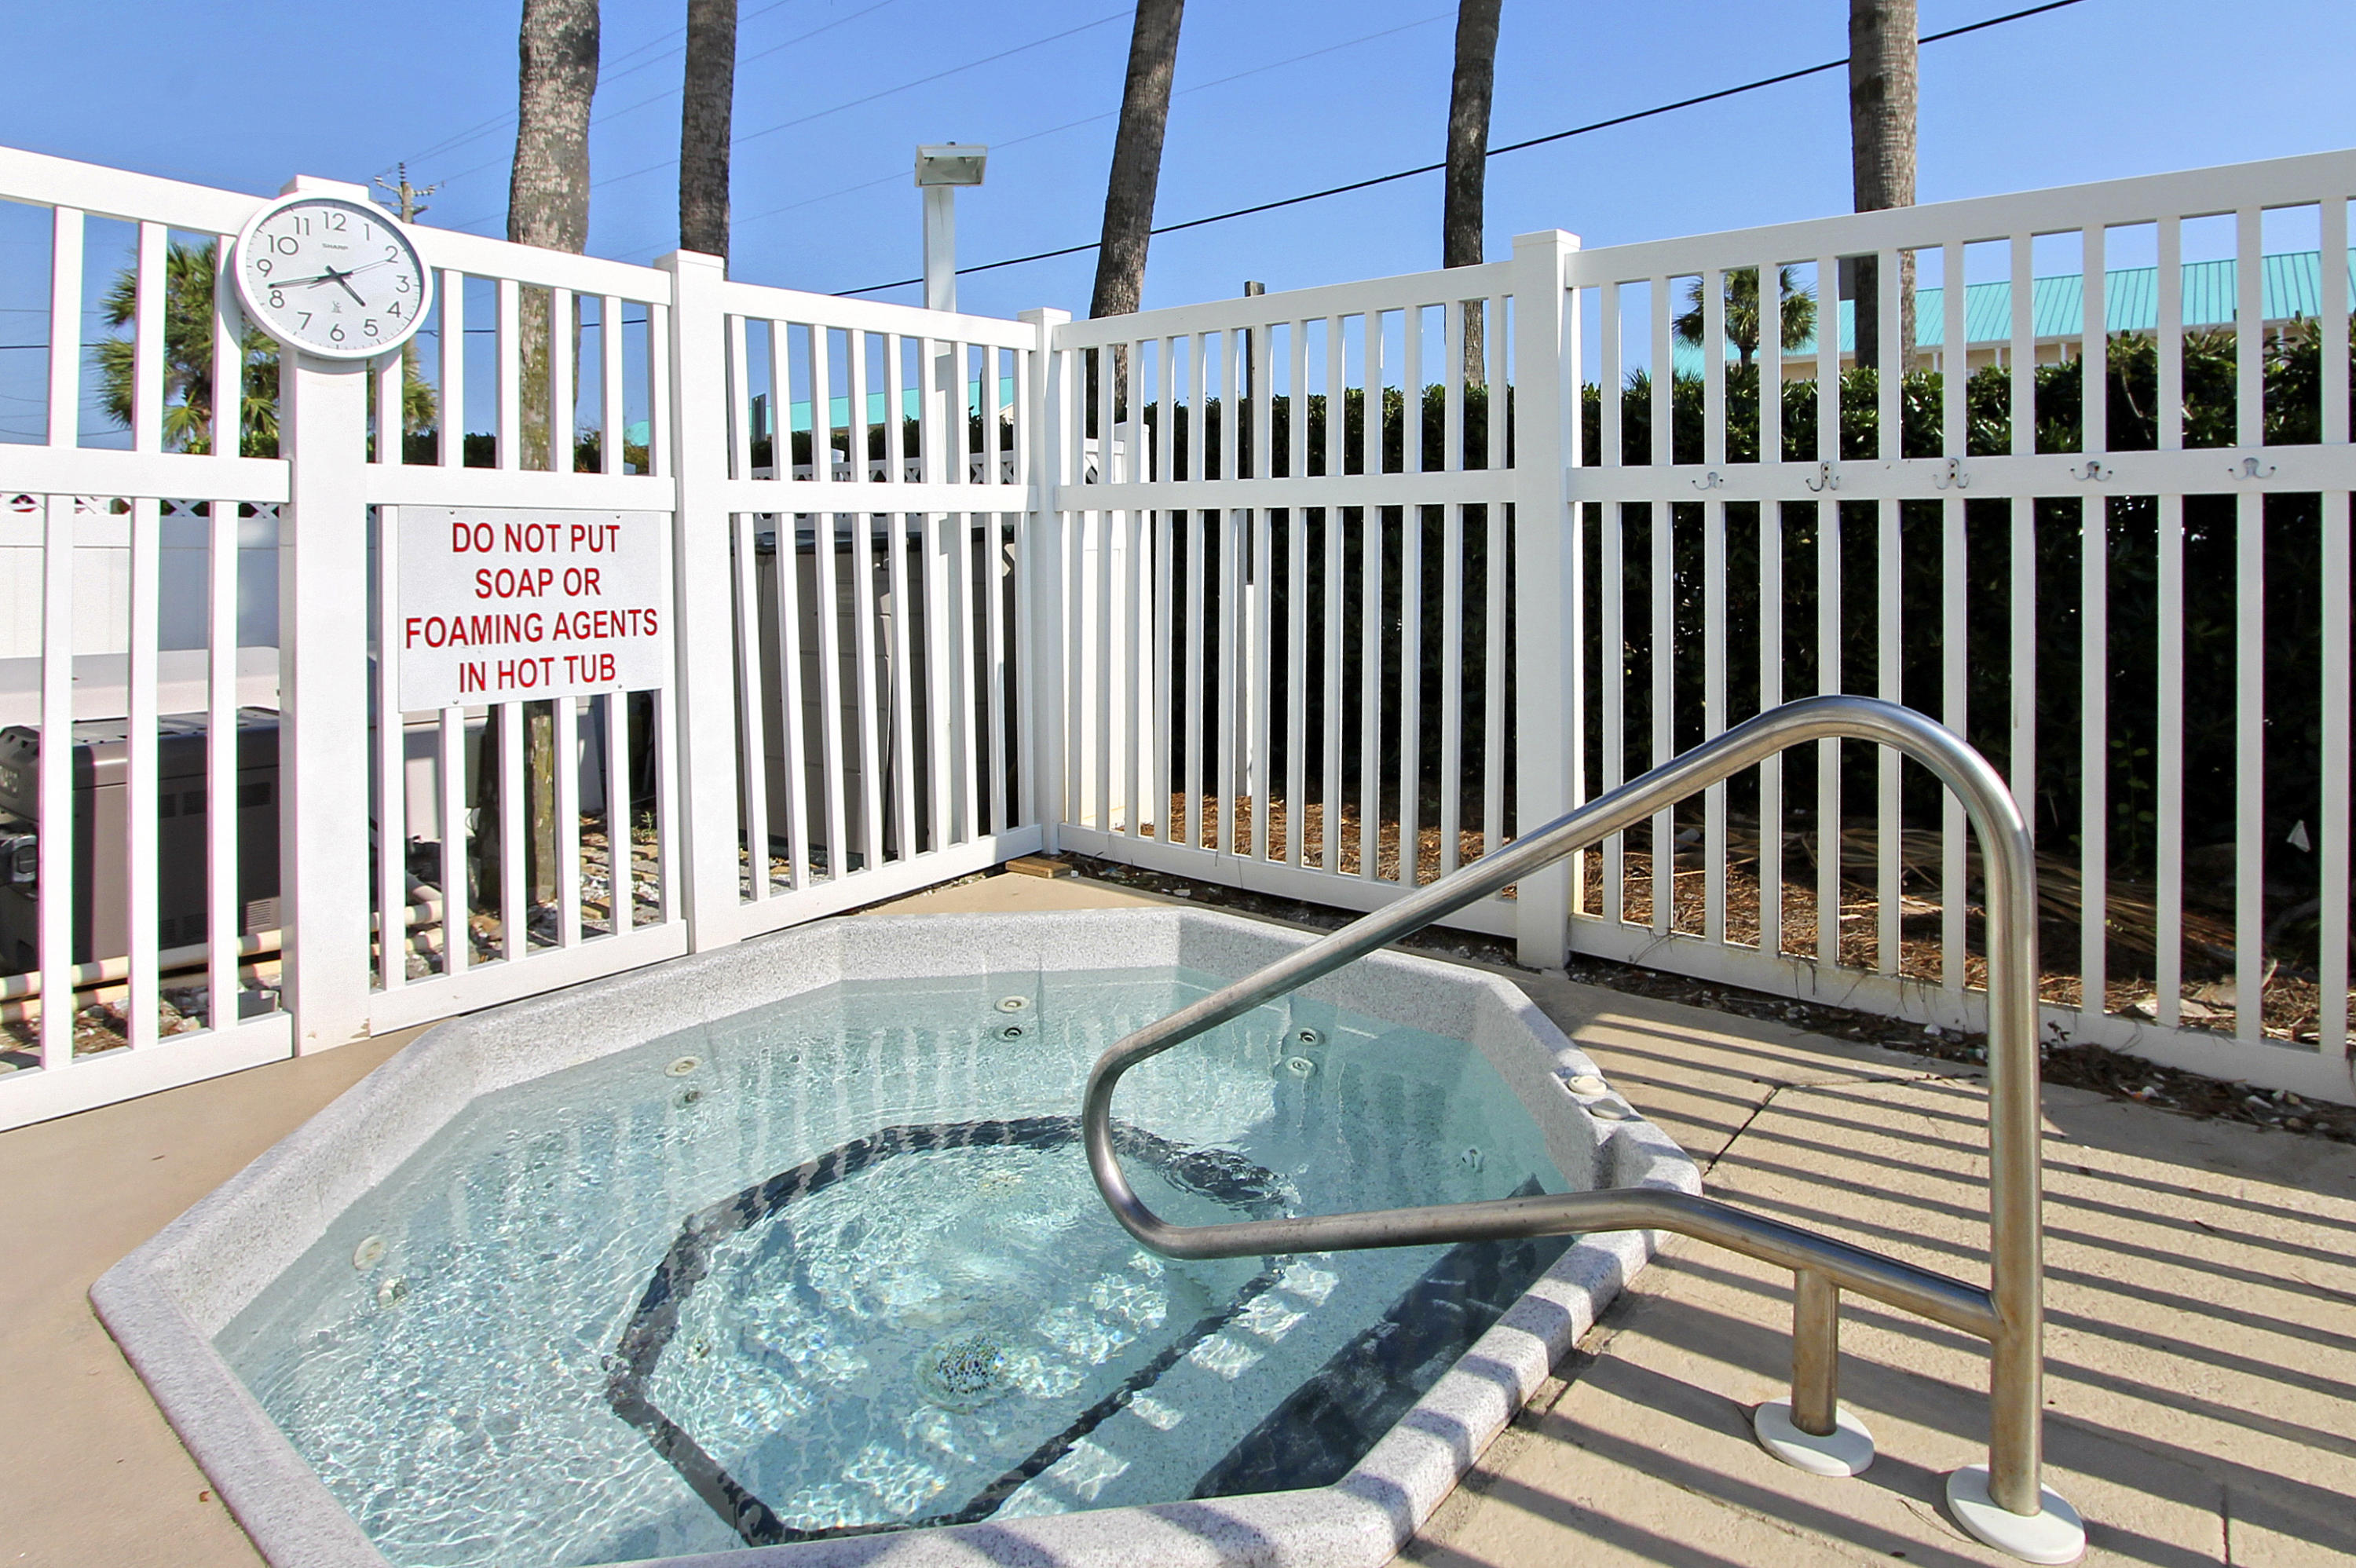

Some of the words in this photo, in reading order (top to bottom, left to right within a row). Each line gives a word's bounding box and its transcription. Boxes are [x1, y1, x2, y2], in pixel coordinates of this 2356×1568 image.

[294, 216, 310, 236] 11
[324, 211, 346, 232] 12
[364, 224, 371, 241] 1
[268, 234, 299, 256] 10
[385, 245, 398, 264] 2
[256, 258, 273, 277] 9
[396, 275, 410, 293] 3
[269, 289, 285, 309] 8
[386, 301, 401, 318] 4
[297, 311, 313, 330] 7
[364, 318, 379, 337] 5
[330, 323, 346, 342] 6
[452, 522, 495, 554] DO
[505, 523, 562, 554] NOT
[571, 524, 621, 554] PUT
[475, 568, 554, 599] SOAP
[563, 567, 602, 598] OR
[405, 612, 544, 649] FOAMING
[552, 609, 658, 641] AGENTS
[460, 661, 487, 693] IN
[498, 656, 556, 690] HOT
[563, 652, 616, 684] TUB
